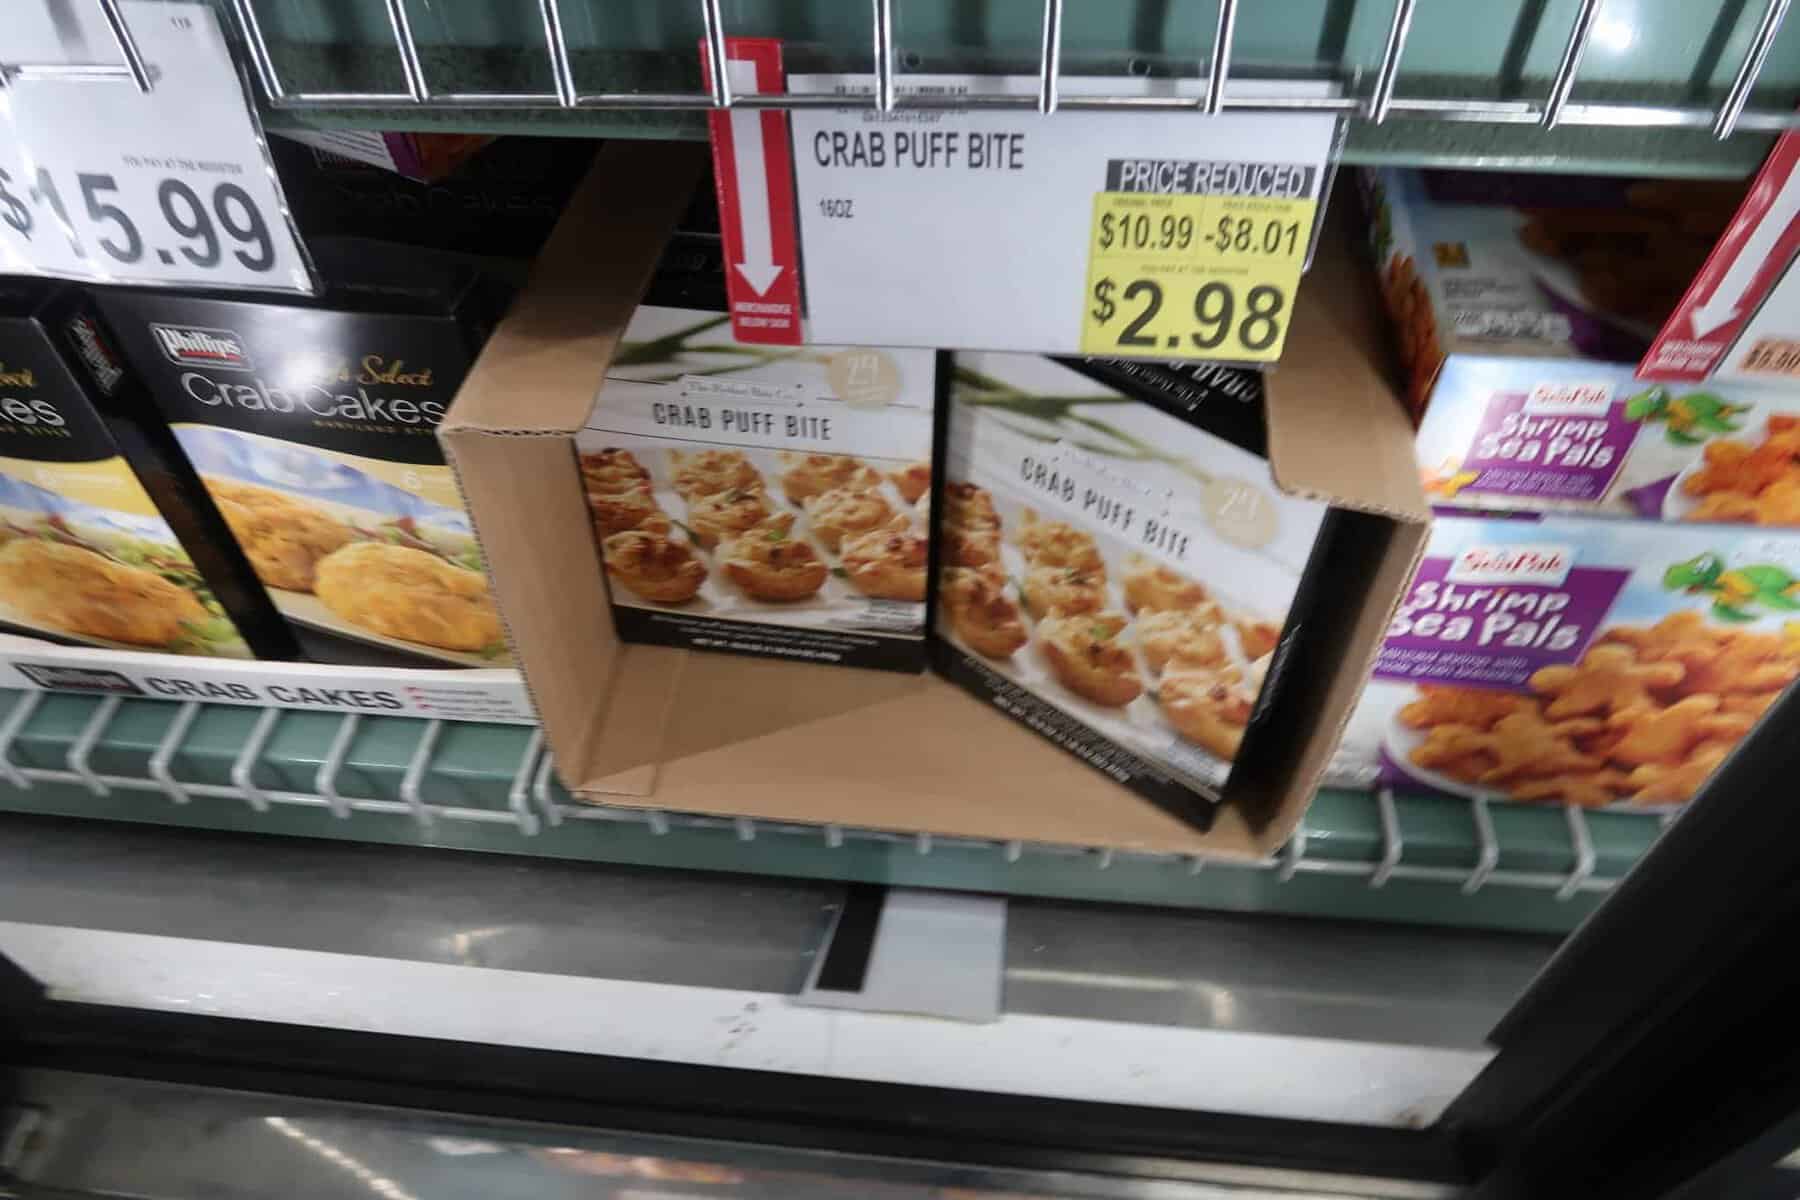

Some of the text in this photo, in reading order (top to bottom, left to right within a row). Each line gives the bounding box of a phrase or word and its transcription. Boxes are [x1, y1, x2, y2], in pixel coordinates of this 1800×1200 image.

[814, 130, 1025, 170] CRAB PUFF BITE
[1119, 161, 1306, 197] PRICE REDUCED
[1099, 211, 1302, 256] $10.99 -$8.01
[1091, 275, 1285, 351] $2.98
[180, 371, 298, 413] Crab
[304, 384, 447, 426] Cakes
[652, 402, 833, 441] CRAB PUFF BITE
[1500, 411, 1610, 442] Shrimp
[1476, 432, 1617, 470] Sea Pals
[1019, 455, 1076, 503] CRAB
[1081, 487, 1137, 532] PUFF
[1143, 517, 1192, 561] BITE
[1413, 580, 1572, 620] Shrimp
[1384, 605, 1582, 651] Sea Pals
[144, 675, 258, 703] CRAB
[268, 683, 404, 710] CAKES
